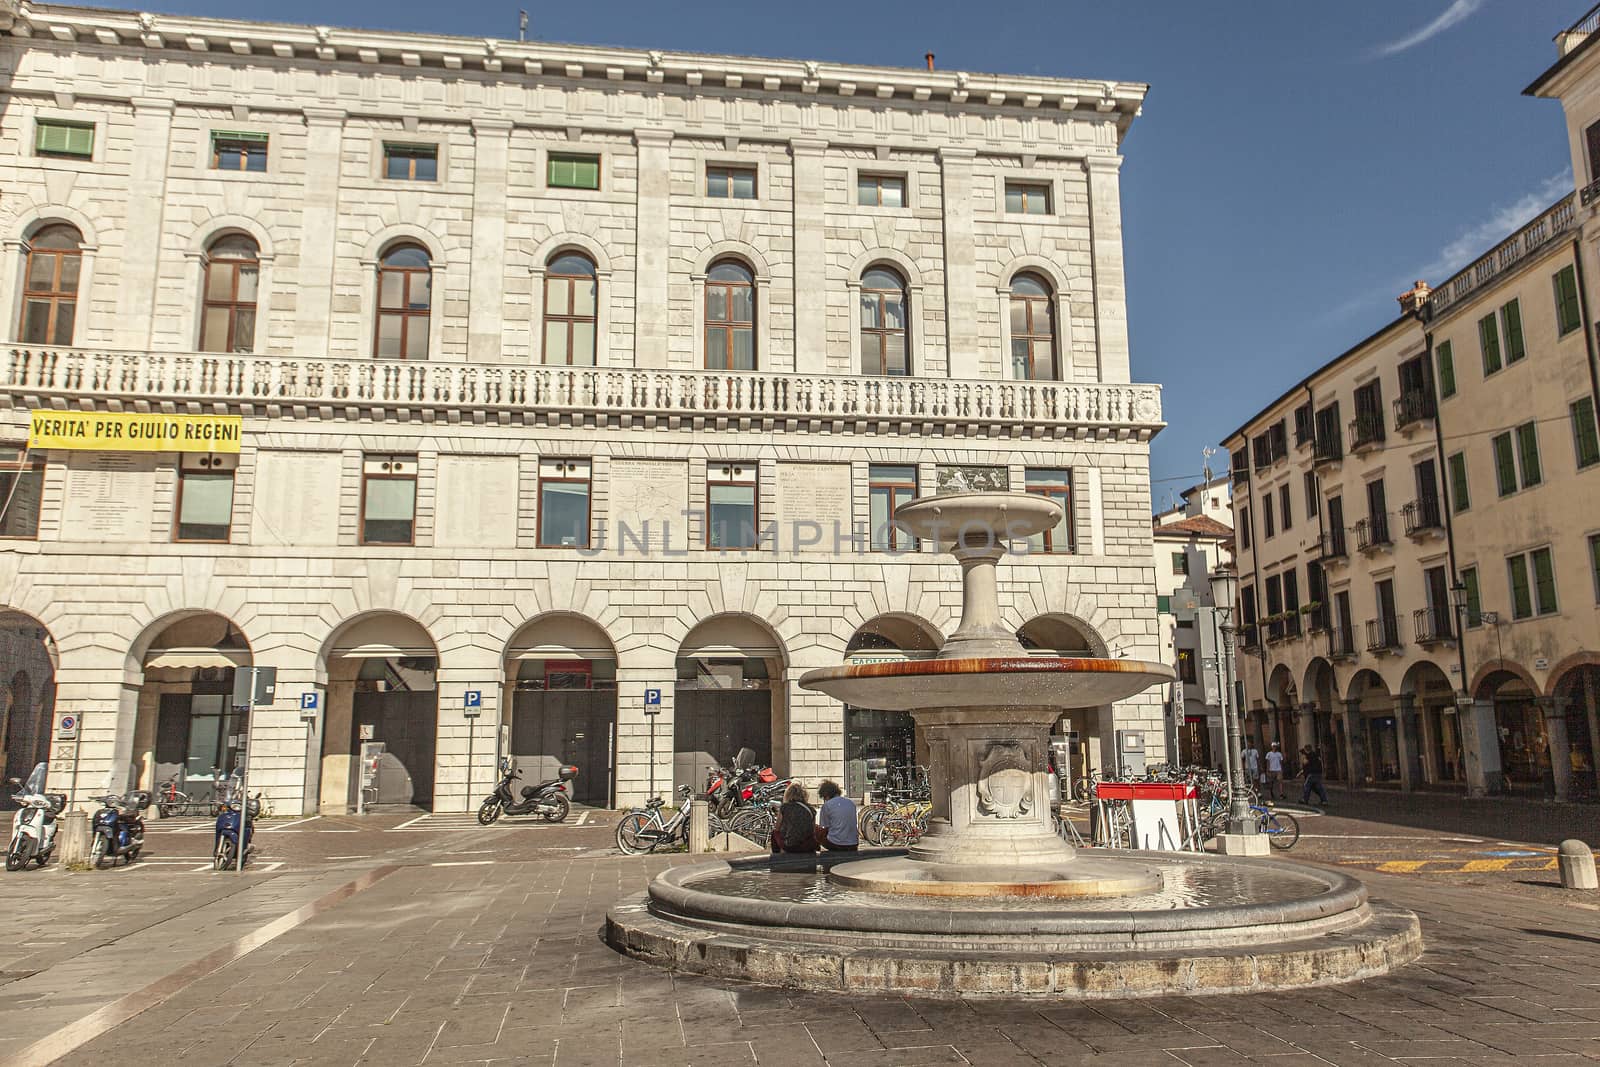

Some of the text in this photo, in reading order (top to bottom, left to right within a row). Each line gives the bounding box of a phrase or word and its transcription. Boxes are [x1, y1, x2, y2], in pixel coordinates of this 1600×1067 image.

[33, 418, 239, 441] VERITA' PER GIULIO REGENI
[303, 694, 315, 708] P
[467, 692, 478, 706] P
[647, 690, 658, 704] P
